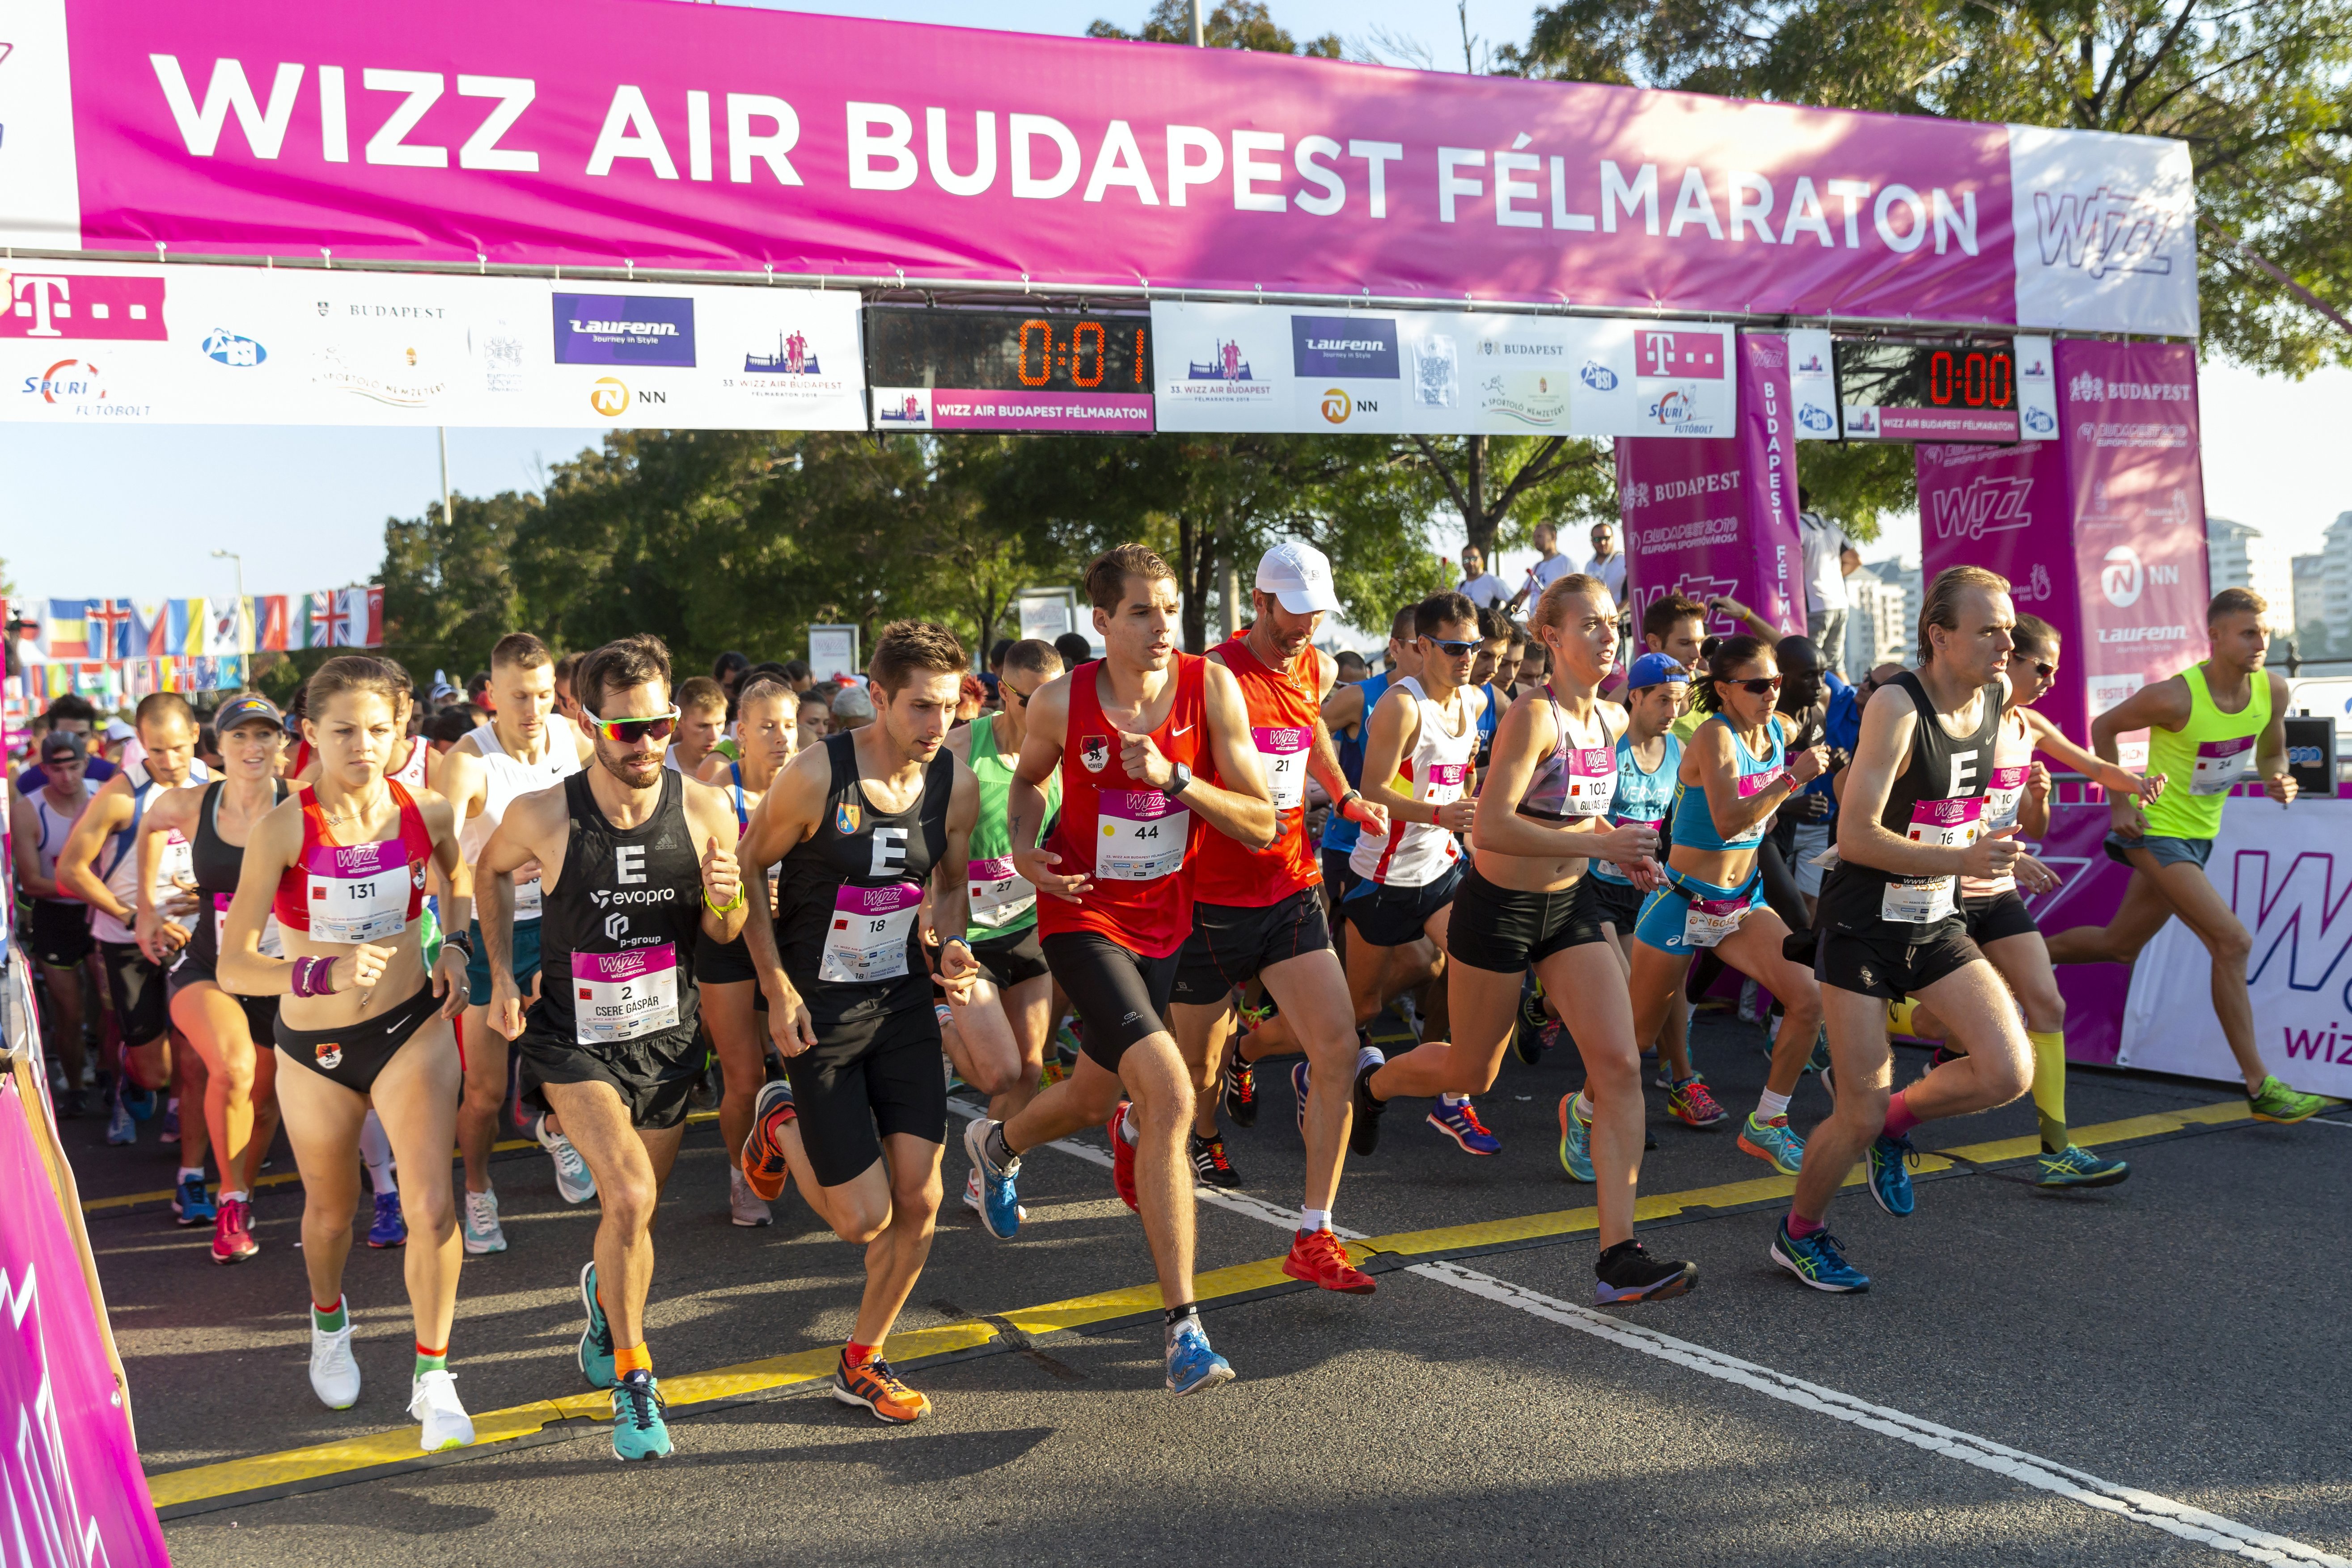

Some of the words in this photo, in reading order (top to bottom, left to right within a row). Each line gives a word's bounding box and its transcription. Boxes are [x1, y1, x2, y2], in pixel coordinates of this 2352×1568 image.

[149, 53, 539, 172] WIZZ
[585, 85, 804, 186] AIR
[846, 101, 1404, 219] BUDAPEST
[1438, 132, 1979, 256] FÉLMARATON
[350, 305, 445, 319] BUDAPEST
[592, 335, 625, 344] Journey
[637, 337, 659, 345] Style
[1505, 344, 1563, 355] BUDAPEST
[791, 381, 842, 389] BUDAPEST
[1595, 372, 1612, 389] BSI
[1931, 351, 2011, 407] 0:00
[639, 392, 666, 404] NN
[2108, 383, 2191, 400] BUDAPEST
[936, 404, 971, 416] WIZZ
[974, 406, 995, 417] AIR
[998, 406, 1063, 418] BUDAPEST
[1066, 405, 1147, 418] FÉLMARATON
[1357, 402, 1377, 412] NN
[1675, 423, 1713, 434] FUTÓBOLT
[1882, 419, 1904, 428] WIZZ
[1905, 420, 1919, 428] AIR
[1921, 420, 1961, 429] BUDAPEST
[1764, 382, 1782, 525] BUDAPEST
[1655, 470, 1740, 502] BUDAPEST
[2149, 566, 2179, 584] NN
[1275, 760, 1289, 772] 21
[1947, 750, 1978, 798] E
[1590, 782, 1606, 795] 102
[1580, 799, 1600, 810] GULYÁS
[1134, 825, 1159, 839] 44
[1942, 833, 1953, 844] 16
[869, 828, 908, 875] E
[616, 845, 646, 884] E
[348, 883, 375, 899] 131
[997, 880, 1012, 892] 27
[613, 888, 674, 905] evopro
[870, 920, 885, 933] 18
[621, 936, 661, 947] p-group
[611, 968, 646, 978] wizzair.com
[622, 987, 632, 1000] 2
[596, 1006, 624, 1016] CSERE
[626, 996, 659, 1014] GÁSPÁR
[1121, 1014, 1143, 1026] Kalenji
